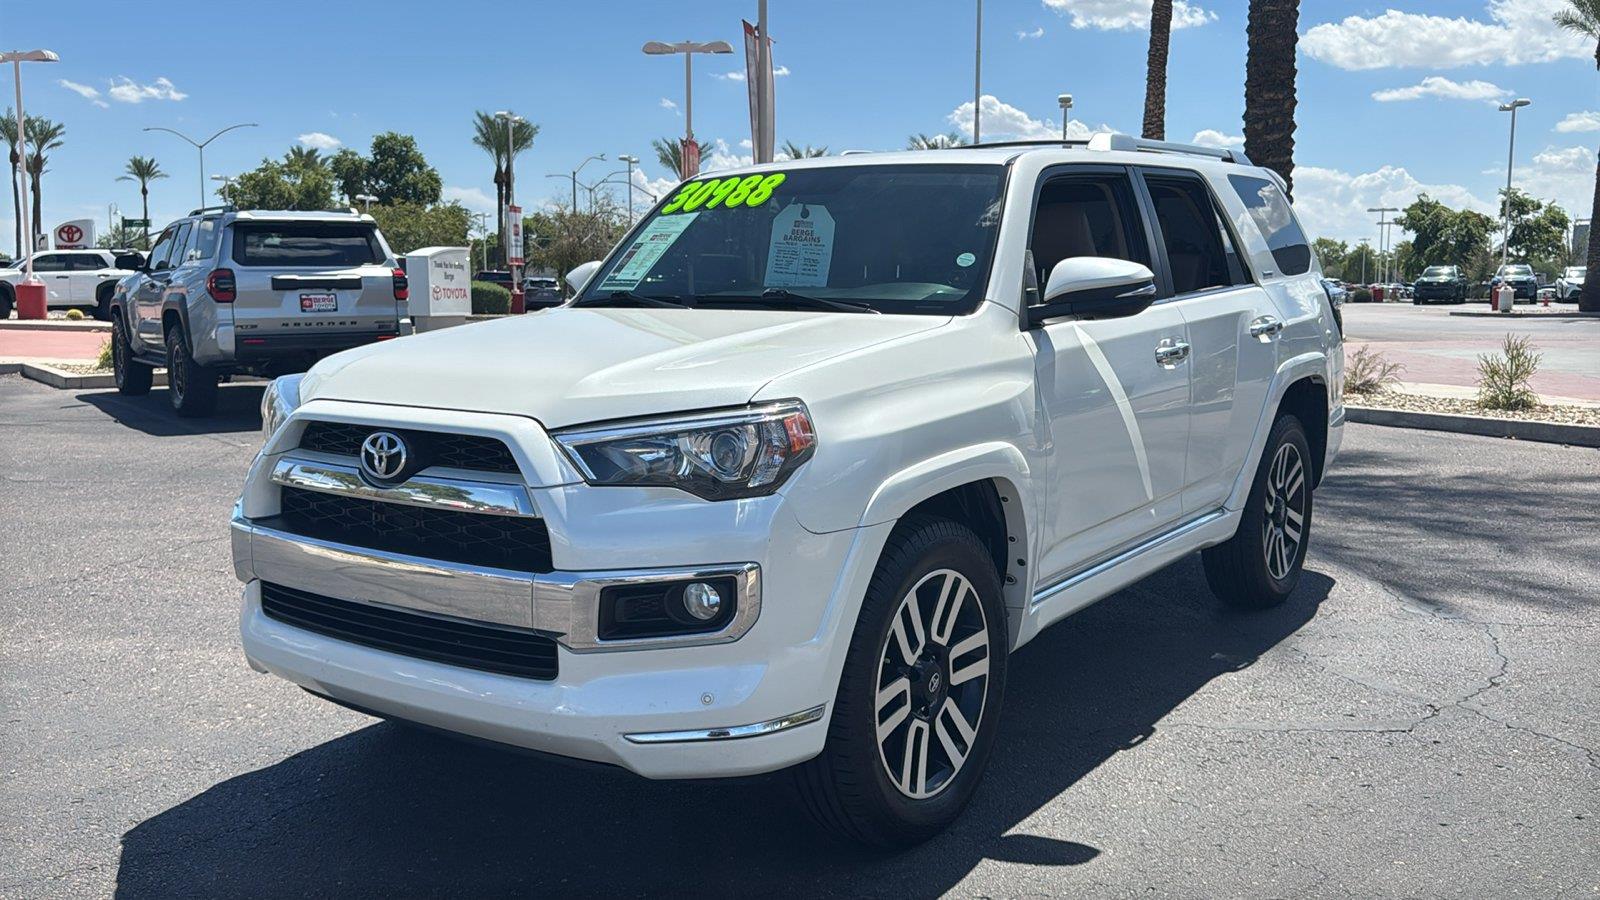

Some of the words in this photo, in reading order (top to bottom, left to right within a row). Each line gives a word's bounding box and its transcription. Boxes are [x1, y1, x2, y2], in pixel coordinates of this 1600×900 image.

[661, 173, 786, 215] 30988
[783, 234, 821, 243] BARGAINS
[442, 287, 467, 299] TOYOTA
